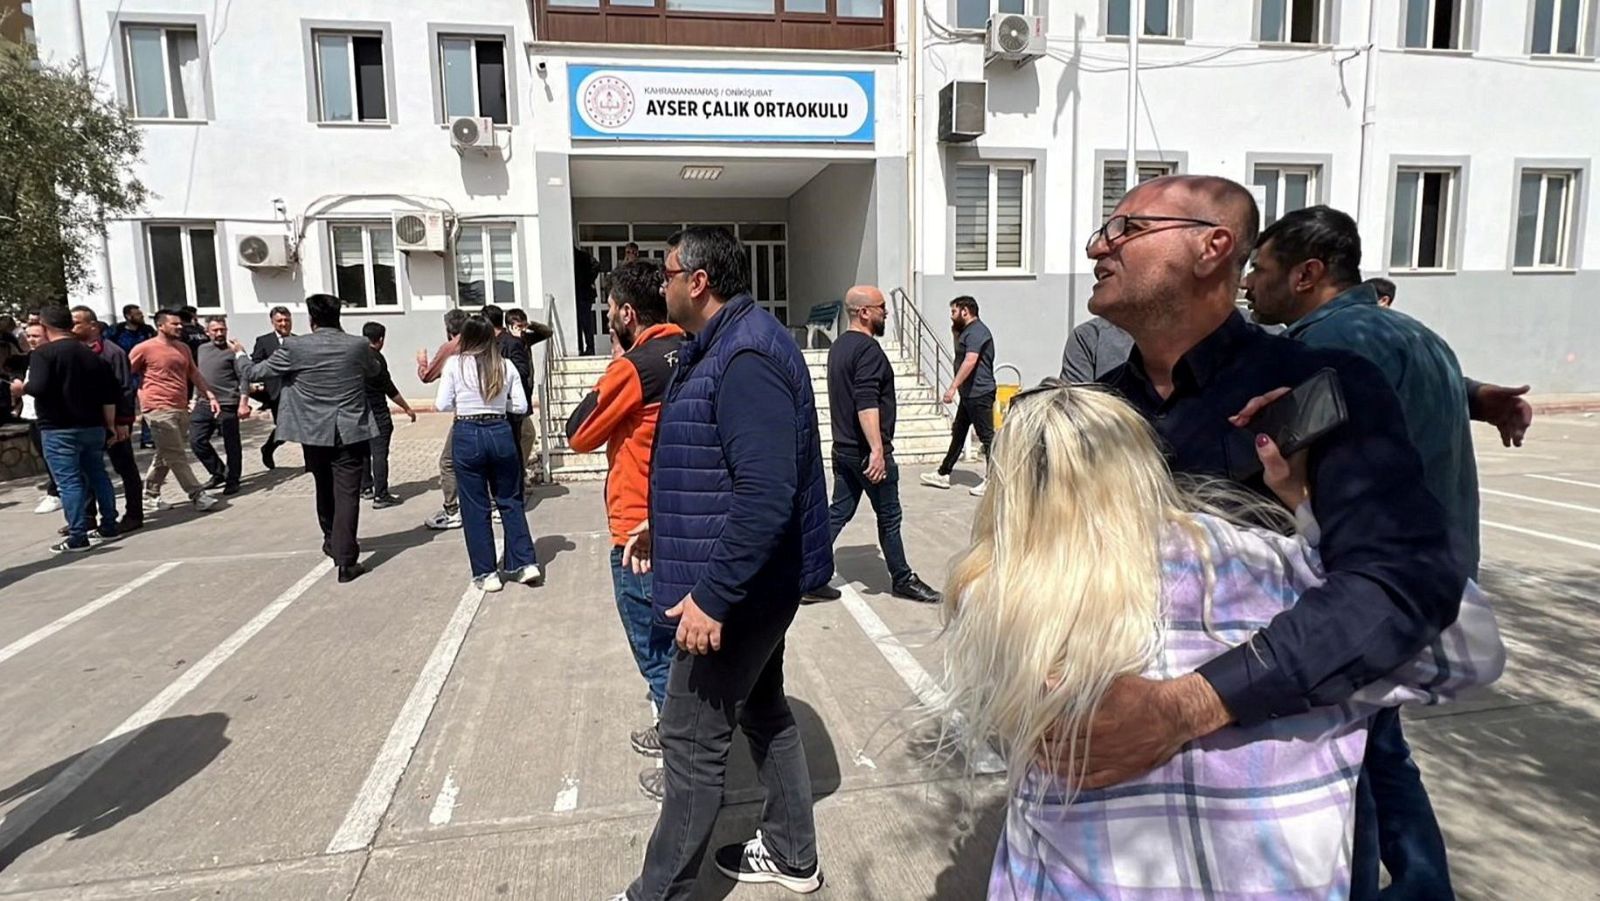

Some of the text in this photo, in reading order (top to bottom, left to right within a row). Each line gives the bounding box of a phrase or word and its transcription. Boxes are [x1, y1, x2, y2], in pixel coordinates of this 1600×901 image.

[644, 87, 718, 97] KAHRAMANMARAŞ
[646, 100, 697, 116] AYSER
[702, 101, 749, 119] ÇALIK
[754, 102, 848, 118] ORTAOKULU
